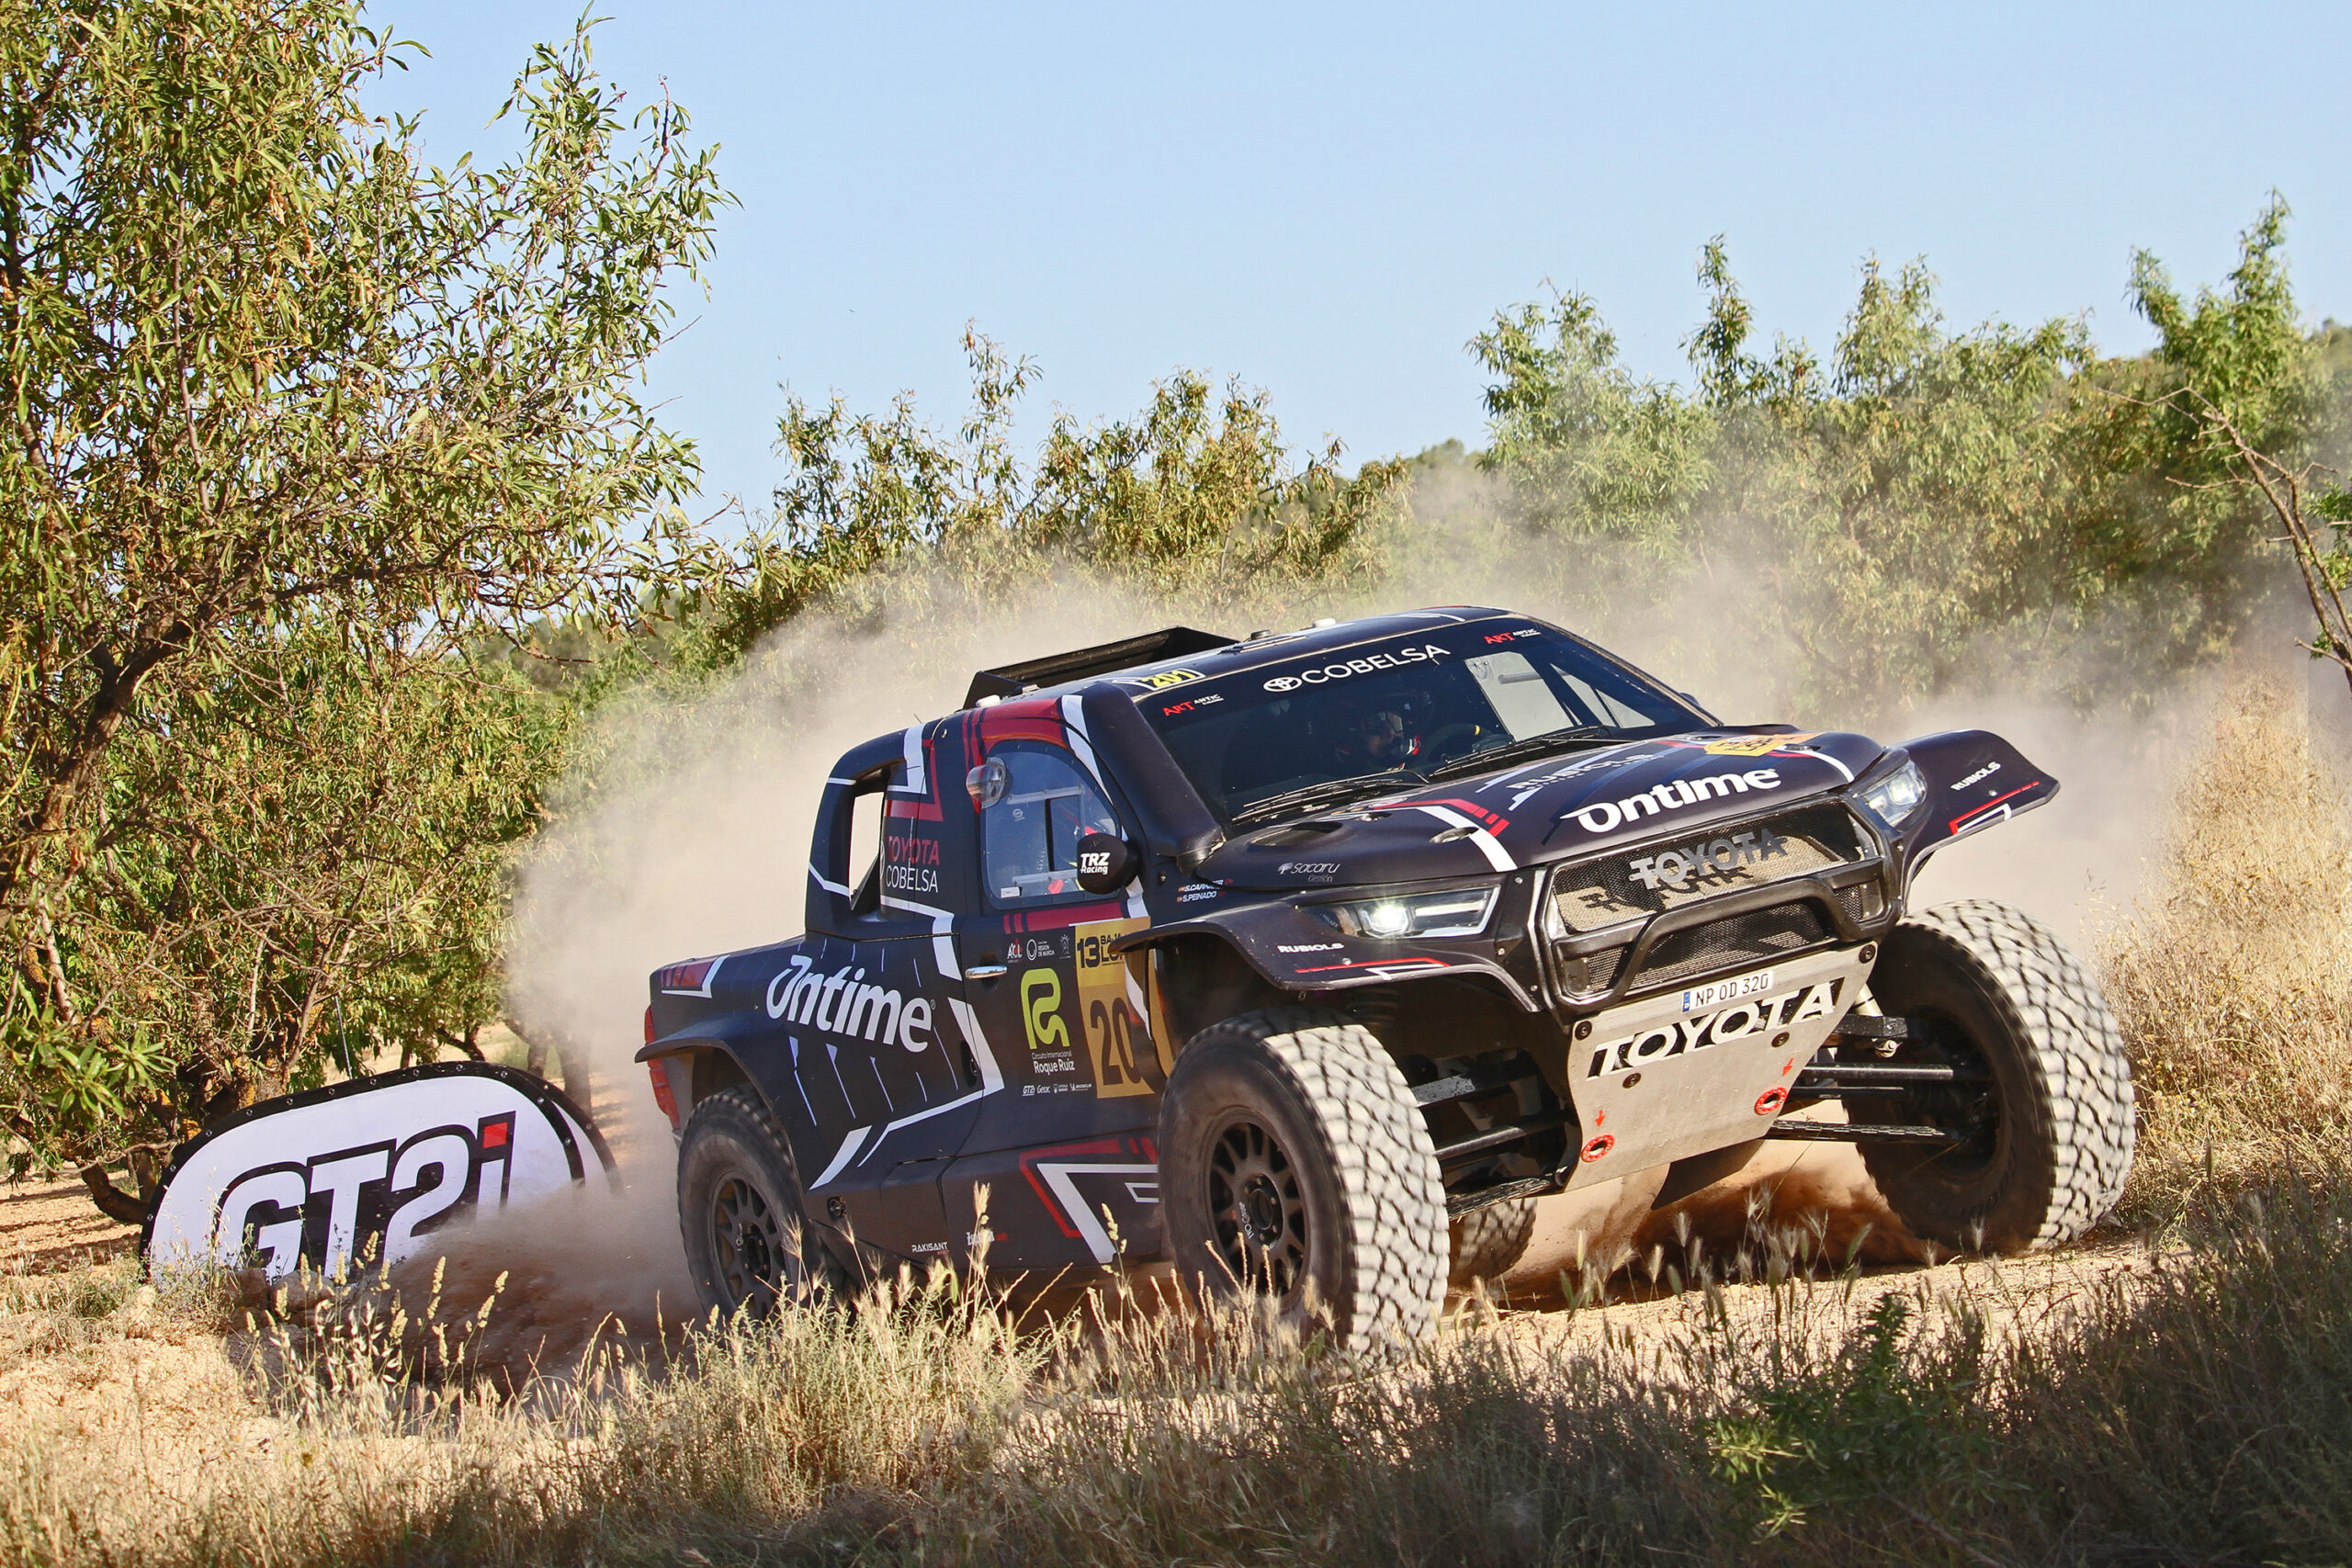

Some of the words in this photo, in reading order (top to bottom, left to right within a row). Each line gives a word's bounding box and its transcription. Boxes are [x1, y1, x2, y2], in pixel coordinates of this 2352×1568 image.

[1483, 632, 1516, 644] ART
[1140, 670, 1197, 687] 201
[1301, 644, 1451, 683] COBELSA
[1162, 701, 1195, 716] ART
[1951, 761, 2001, 791] RUBIOLS
[1560, 769, 1781, 833] Ontime
[887, 835, 940, 865] TOYOTA
[1080, 852, 1111, 867] TRZ
[1629, 827, 1788, 890] TOYOTA
[886, 864, 939, 894] COBELSA
[1080, 864, 1109, 875] Racing
[1077, 936, 1101, 968] 13
[1277, 942, 1345, 953] RUBIOLS
[766, 954, 932, 1053] Ontime
[1696, 987, 1714, 1007] NP
[1719, 981, 1737, 1000] OD
[1742, 973, 1769, 995] 320
[1589, 978, 1843, 1080] TOYOTA
[1034, 1060, 1058, 1076] Roque
[1058, 1058, 1075, 1071] Ruiz
[217, 1111, 516, 1286] GT2i
